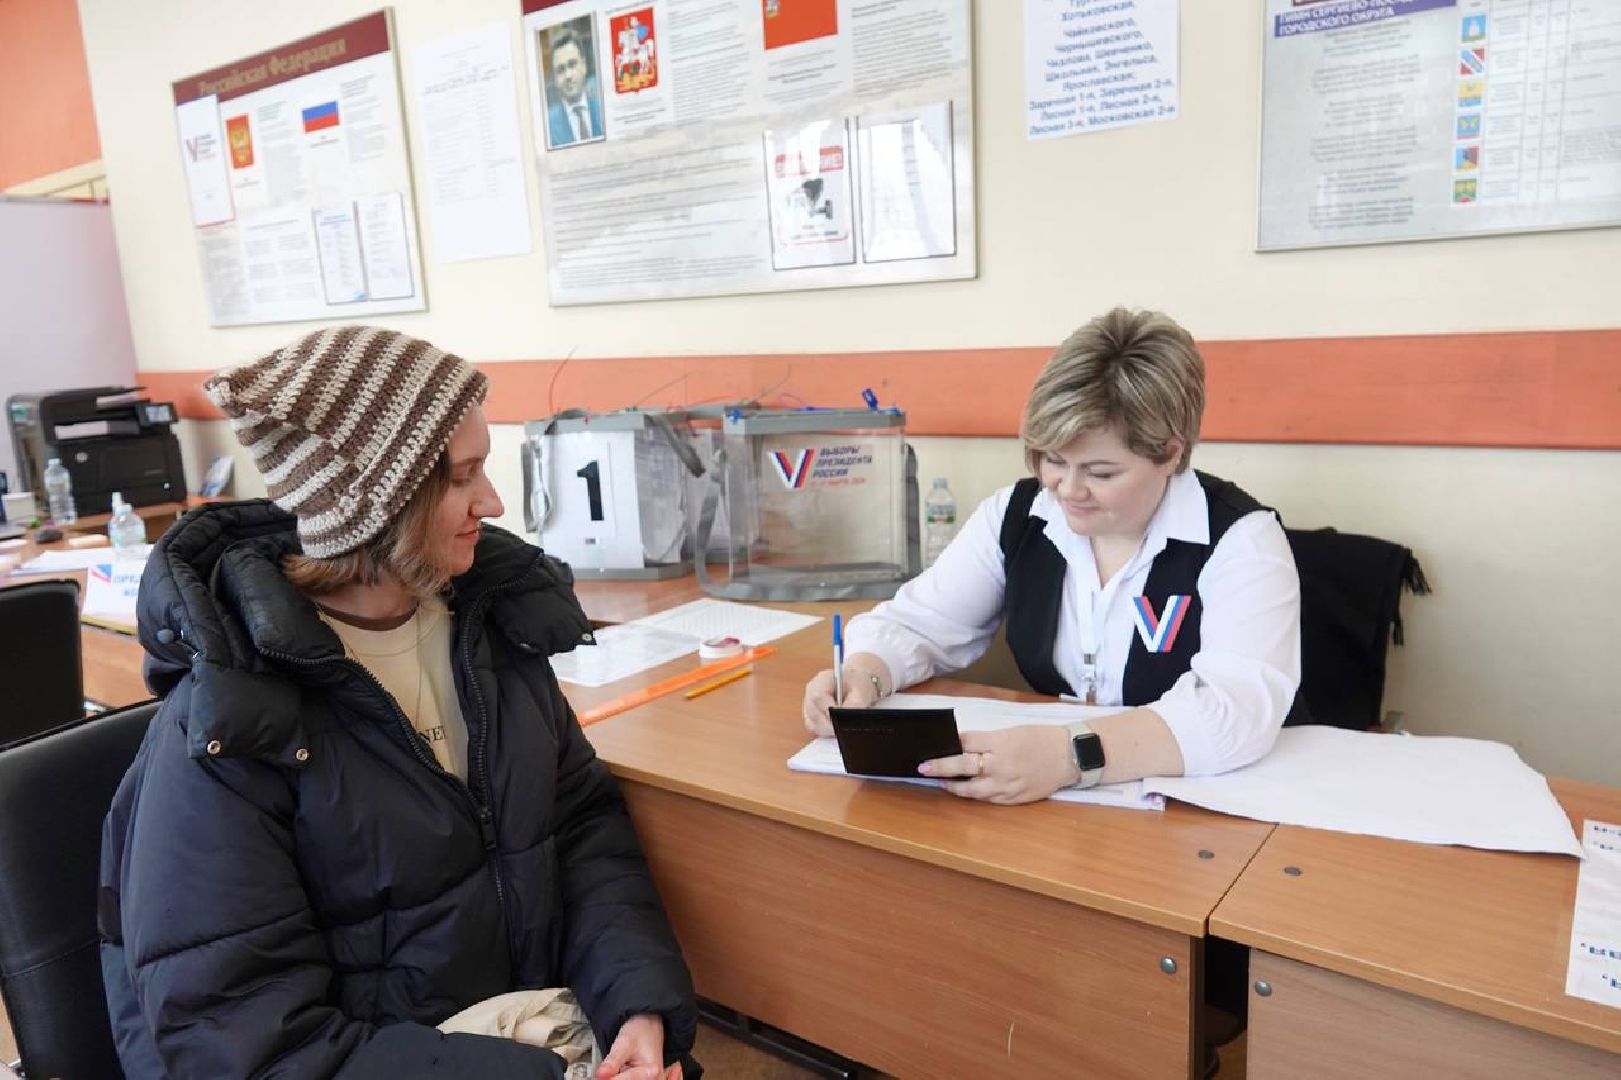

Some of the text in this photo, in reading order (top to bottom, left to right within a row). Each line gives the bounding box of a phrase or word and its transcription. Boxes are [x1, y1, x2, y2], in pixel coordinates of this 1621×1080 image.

[820, 445, 861, 457] ВЫБОРЫ
[815, 455, 873, 467] ПРЕЗИДЕНТА
[813, 468, 849, 478] РОССИИ
[577, 460, 604, 521] 1
